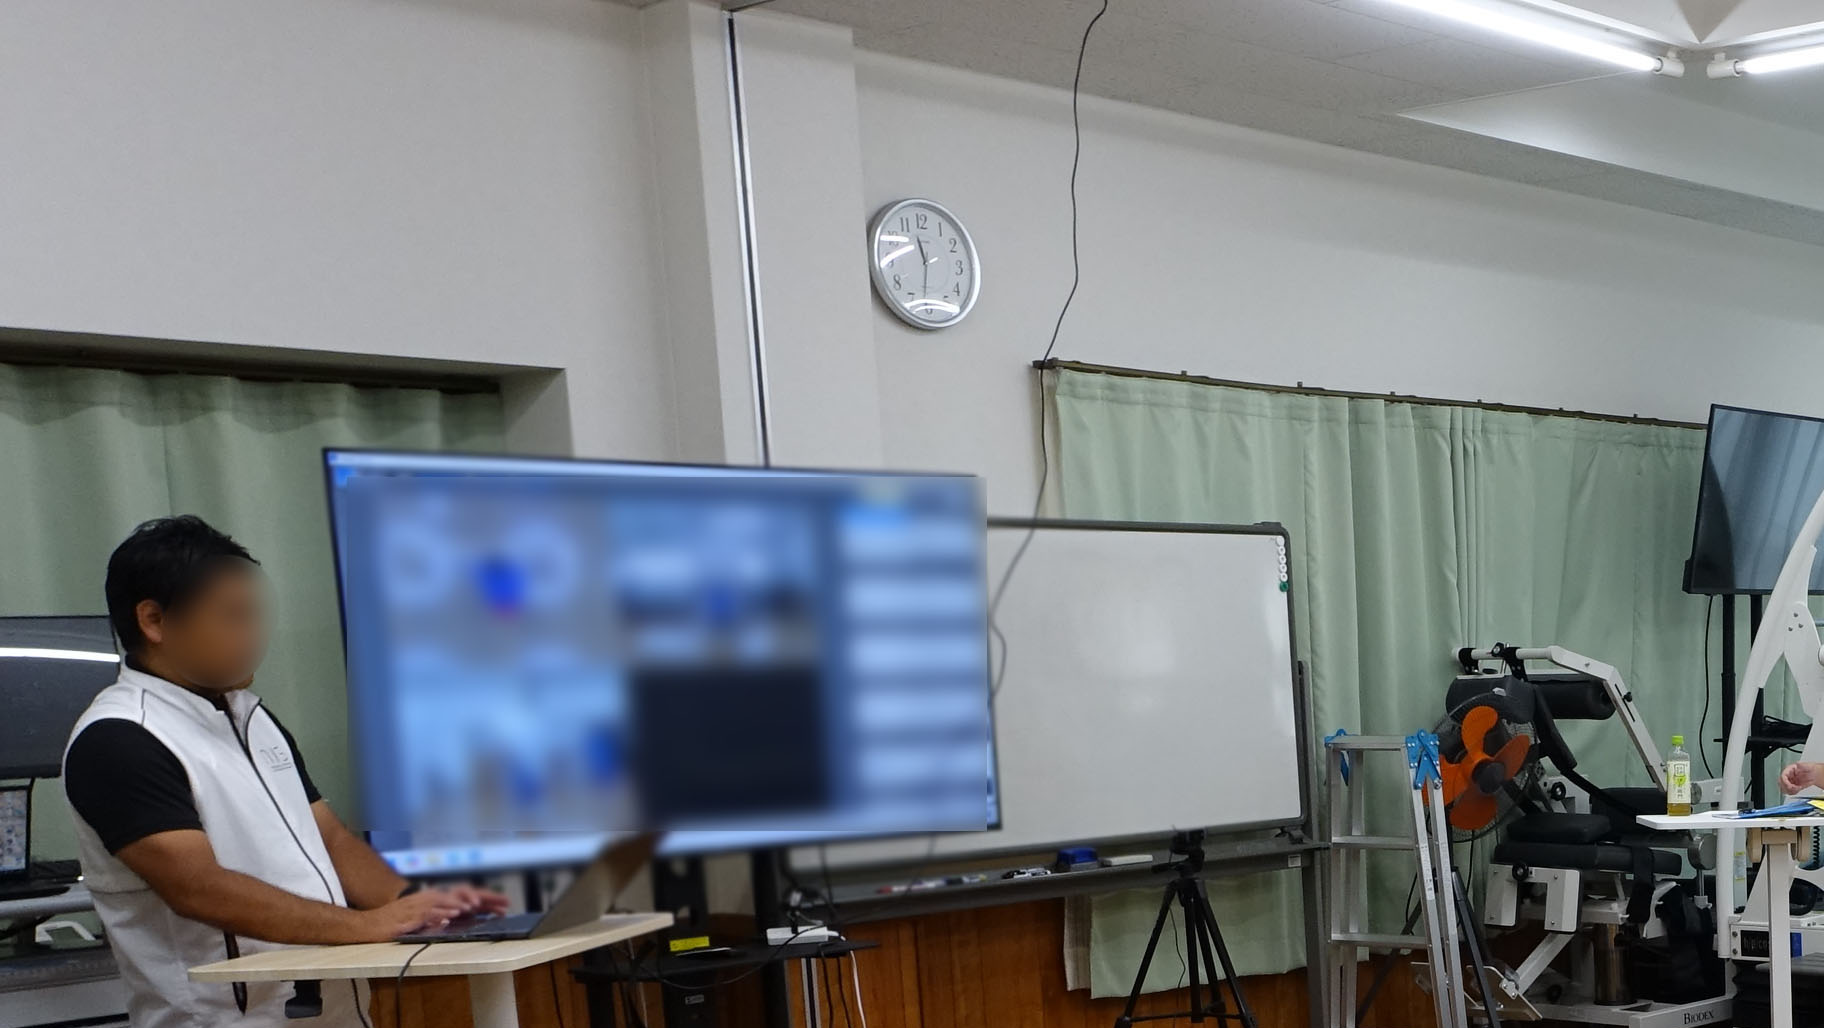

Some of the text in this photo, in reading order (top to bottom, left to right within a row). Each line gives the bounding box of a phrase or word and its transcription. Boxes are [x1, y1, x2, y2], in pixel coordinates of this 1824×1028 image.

[900, 217, 910, 232] 11
[916, 213, 928, 230] 12
[938, 222, 942, 237] 1
[949, 238, 957, 253] 2
[955, 260, 963, 276] 3
[893, 274, 901, 291] 8
[953, 281, 960, 296] 4
